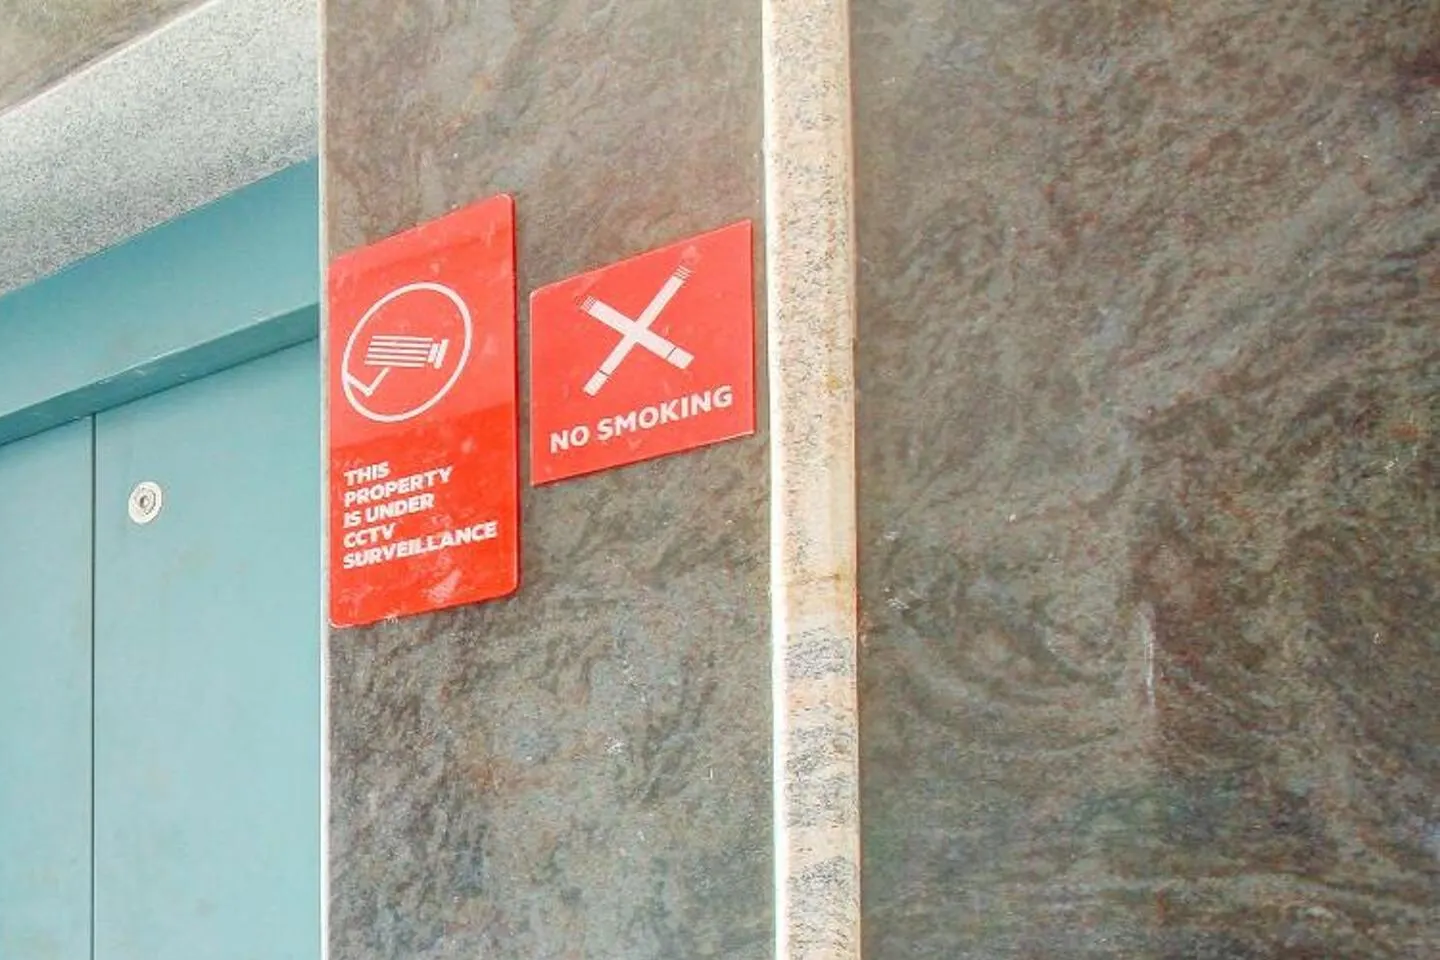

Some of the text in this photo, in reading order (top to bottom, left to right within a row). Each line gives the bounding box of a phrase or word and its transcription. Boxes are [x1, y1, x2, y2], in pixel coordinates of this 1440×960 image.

[549, 385, 733, 454] NO SMOKING
[344, 462, 390, 486] THIS
[344, 466, 453, 507] PROPERTY
[343, 493, 435, 528] IS UNDER
[343, 522, 396, 548] CCTV
[343, 520, 498, 569] SURVEILLANCE
